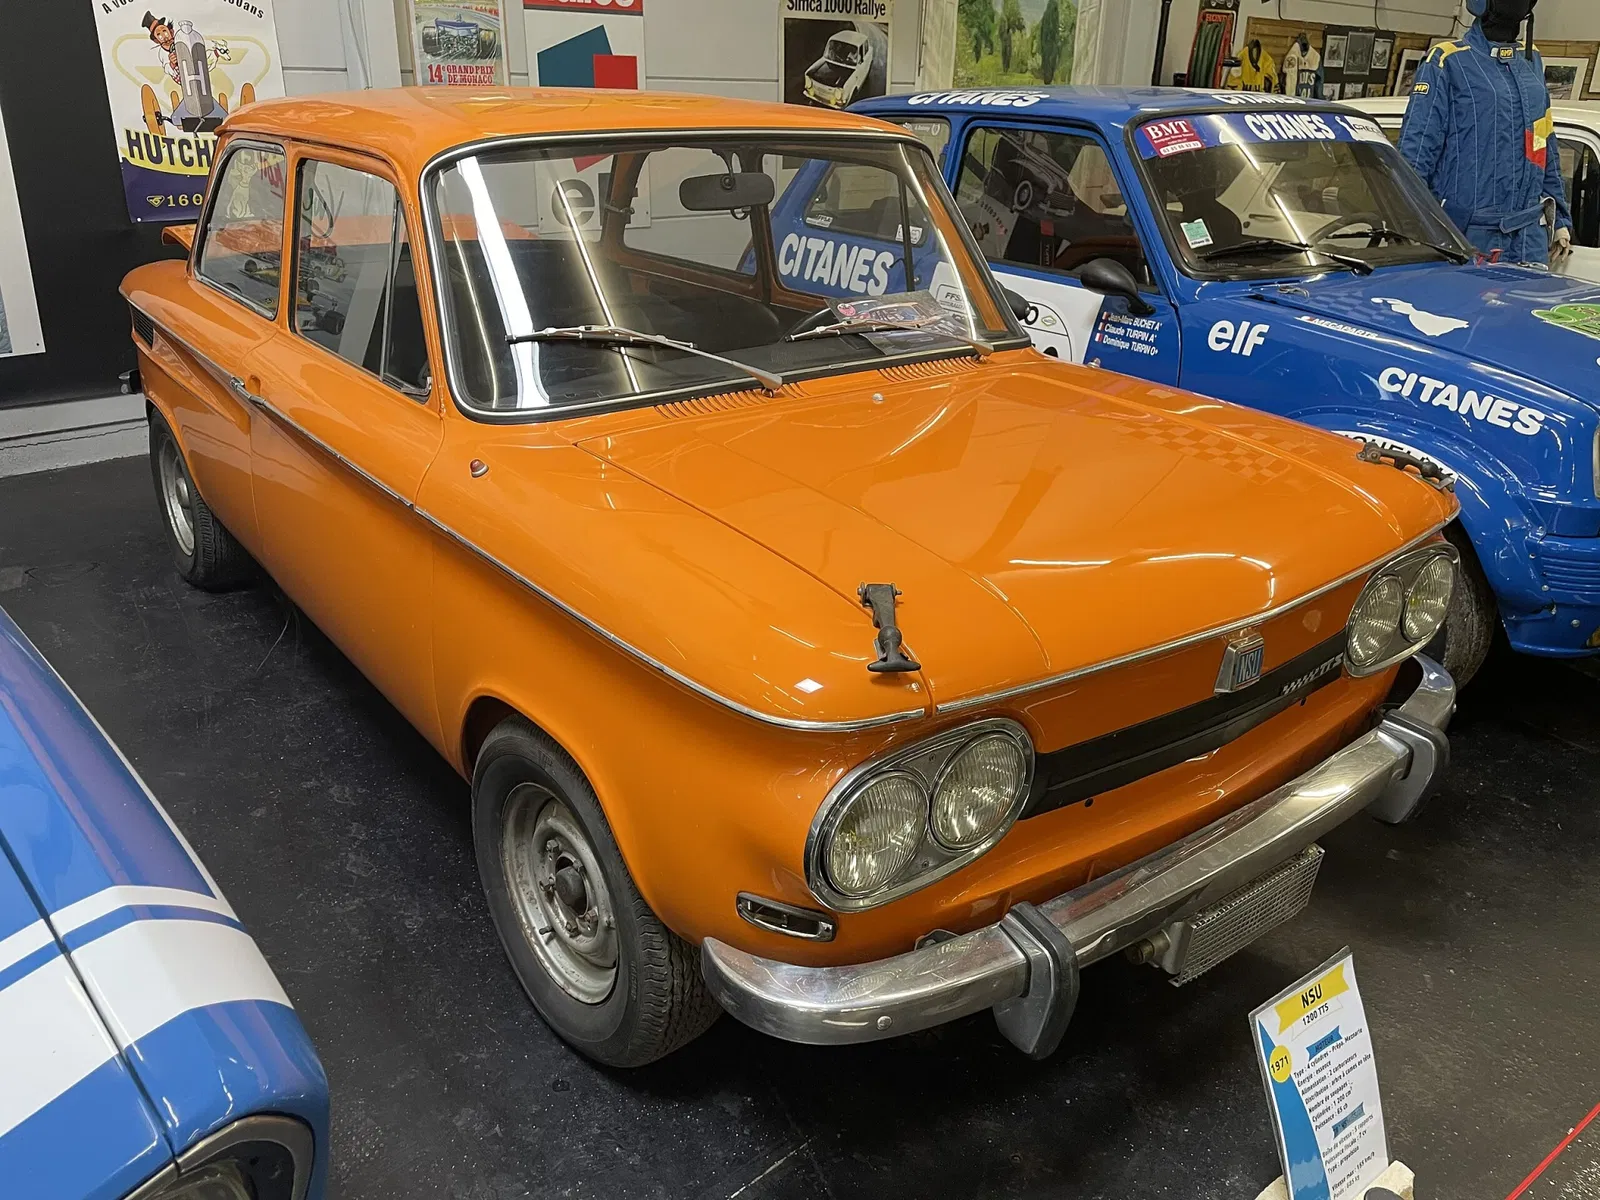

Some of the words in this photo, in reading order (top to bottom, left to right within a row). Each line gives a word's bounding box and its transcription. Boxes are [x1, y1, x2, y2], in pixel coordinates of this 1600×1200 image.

[101, 3, 112, 14] A
[786, 0, 822, 13] Simca
[823, 0, 852, 14] 1000
[854, 0, 886, 19] Rallye
[446, 64, 475, 75] GRAND
[475, 65, 495, 75] PRIX
[447, 74, 459, 84] DE
[460, 74, 494, 84] MONACO
[908, 91, 1050, 107] CITANES
[1146, 120, 1188, 140] BMT
[1243, 114, 1336, 141] CITANES
[779, 232, 894, 297] CITANES
[945, 291, 963, 302] FFS
[1104, 323, 1125, 336] Claude
[1126, 327, 1150, 342] TURPIN
[1132, 317, 1156, 330] BUCHET
[1102, 334, 1130, 350] Dominique
[1131, 341, 1152, 355] TURPIN
[1208, 319, 1270, 357] elf
[1378, 366, 1546, 436] CITANES
[1239, 650, 1262, 683] NSU
[1301, 984, 1322, 1009] NSU
[1303, 1010, 1318, 1025] 1200
[1318, 1003, 1329, 1015] TTS
[1271, 1055, 1288, 1073] 1971
[1293, 1069, 1304, 1078] Type
[1311, 1051, 1329, 1067] cylindres
[1316, 1061, 1331, 1074] essence
[1302, 1075, 1326, 1096] Alimentation
[1333, 1053, 1357, 1073] carburateurs
[1305, 1085, 1329, 1105] Distribution
[1332, 1075, 1342, 1086] arbre
[1345, 1063, 1357, 1075] cames
[1309, 1099, 1324, 1113] Nombre
[1315, 1114, 1334, 1131] Puissance
[1328, 1164, 1337, 1174] Type
